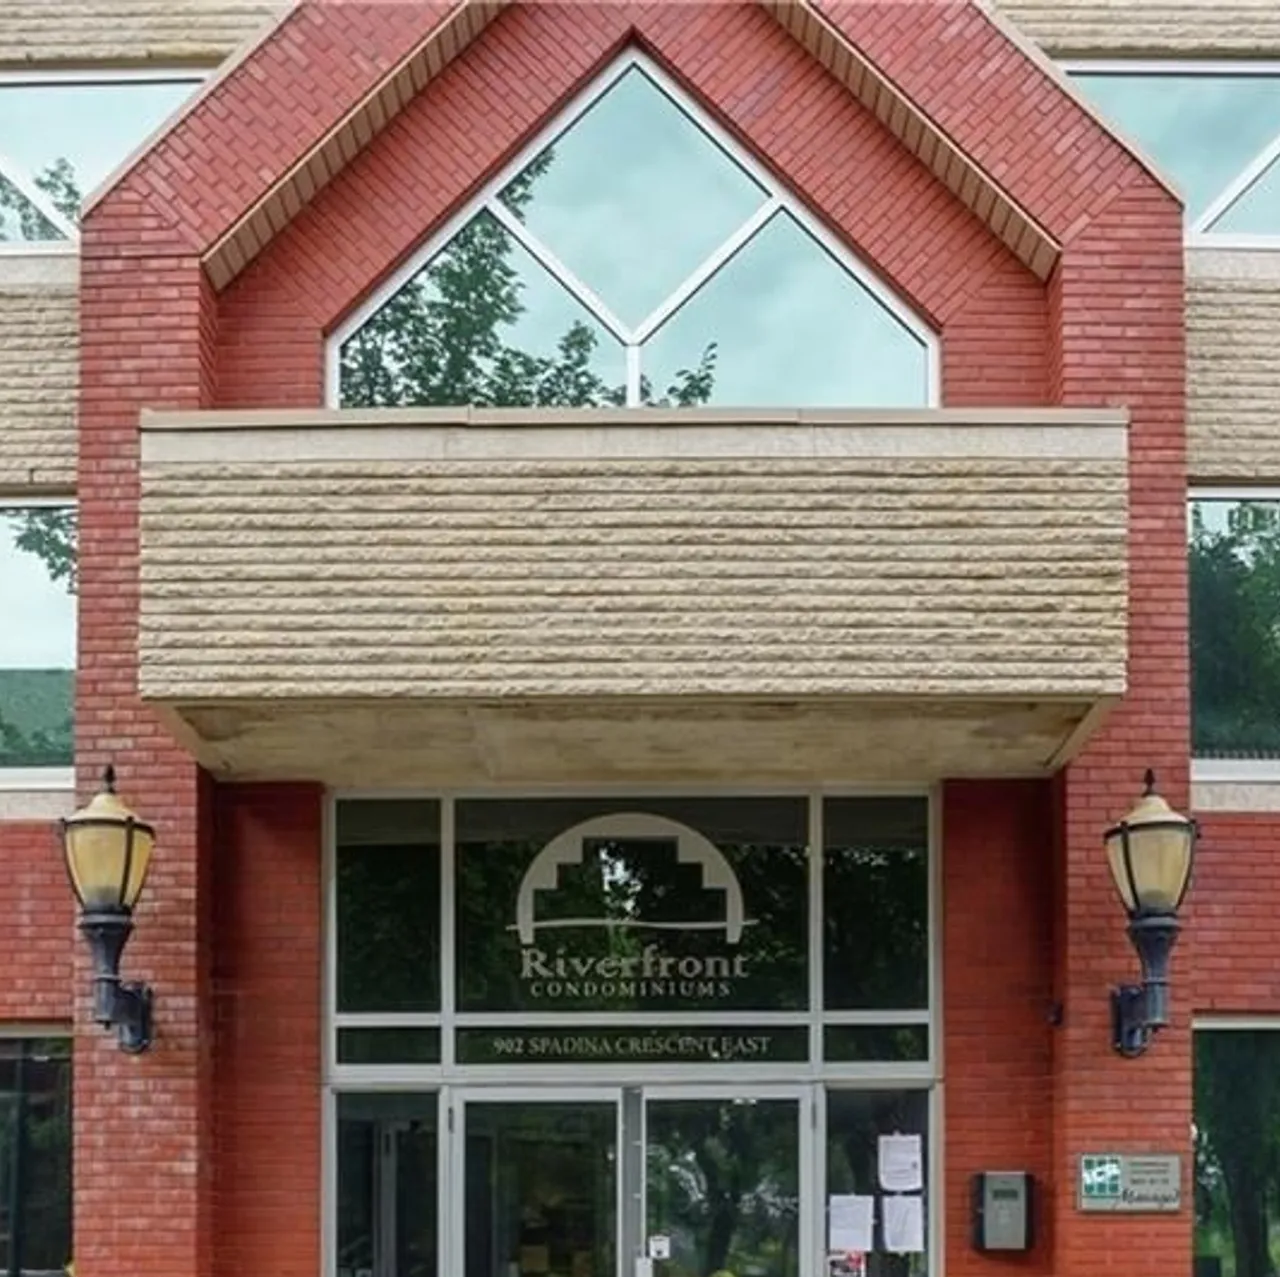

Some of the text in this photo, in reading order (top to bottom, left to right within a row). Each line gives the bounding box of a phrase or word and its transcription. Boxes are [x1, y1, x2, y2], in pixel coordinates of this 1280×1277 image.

[520, 944, 751, 979] Riverfront
[530, 980, 732, 998] CONDOMINIUMS
[493, 1035, 772, 1055] 902 SPADINA CRESCENT EAST
